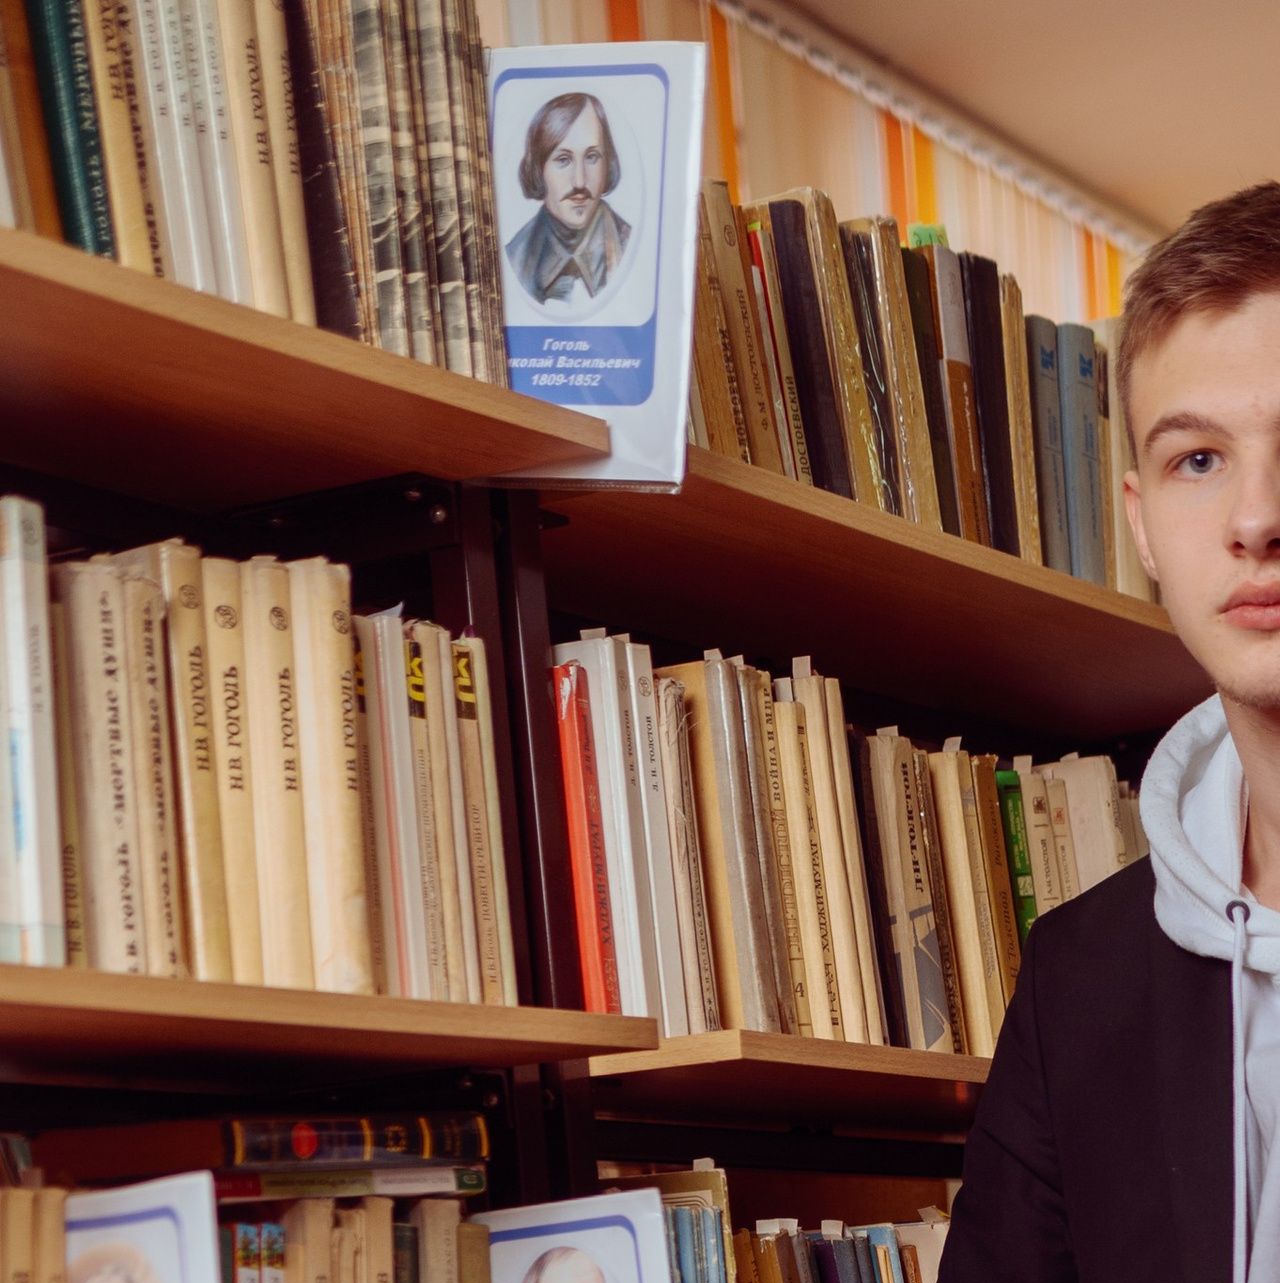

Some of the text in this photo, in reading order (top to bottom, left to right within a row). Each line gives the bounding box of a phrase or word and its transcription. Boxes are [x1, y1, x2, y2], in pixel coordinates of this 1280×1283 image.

[244, 36, 265, 122] ГОГОЛЬ
[542, 338, 591, 351] Гоголь
[556, 355, 641, 369] Васильевич
[735, 286, 763, 397] ДОСТОЕВСКИЙ
[531, 374, 602, 387] 1809-1852
[784, 373, 810, 477] ДОСТОЕВСКИЙ
[188, 644, 207, 729] ГОГОЛЬ
[222, 664, 242, 749] ГОГОЛЬ
[276, 666, 295, 749] ГОГОЛЬ
[339, 668, 357, 748] ГОГОЛЬ
[761, 686, 774, 726] МИР
[643, 714, 656, 764] ТОЛСТОЙ
[765, 729, 775, 742] И
[767, 746, 781, 802] ВОЙНА
[808, 838, 831, 953] ХАДЖИ-МУРАТ
[795, 982, 805, 998] 4
